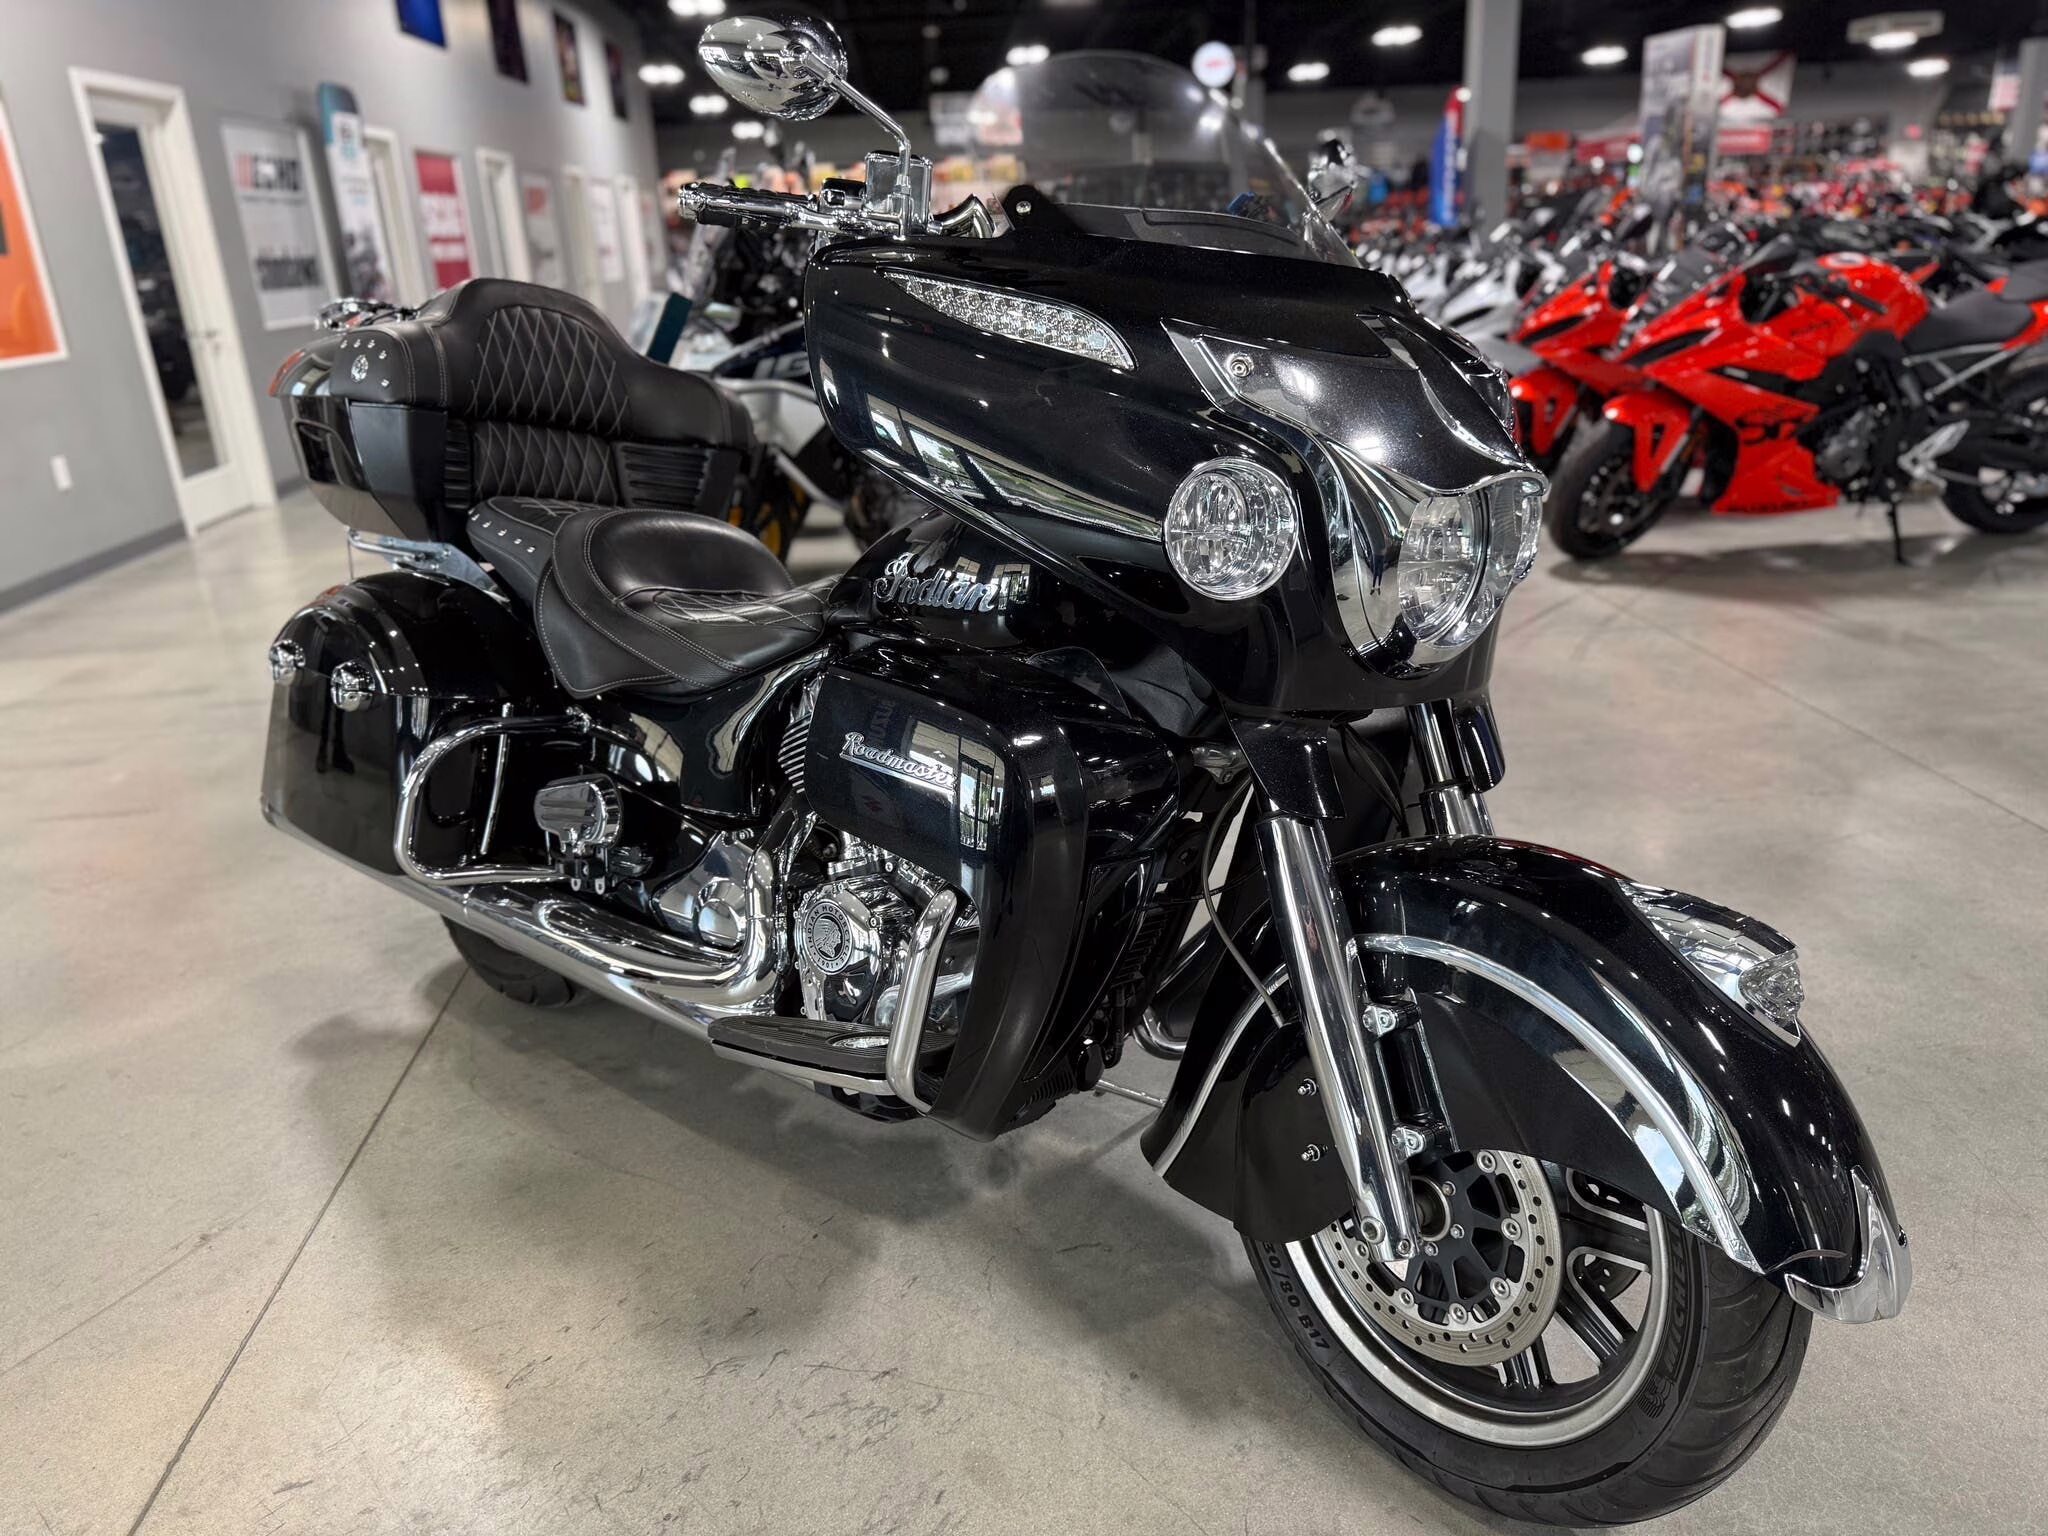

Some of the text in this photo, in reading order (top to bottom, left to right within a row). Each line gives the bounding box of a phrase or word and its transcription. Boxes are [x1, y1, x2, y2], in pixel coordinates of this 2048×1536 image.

[873, 552, 998, 612] Indian
[842, 731, 957, 788] Roadmaster
[807, 905, 850, 969] INDIAN MOTORCYCLE 1901
